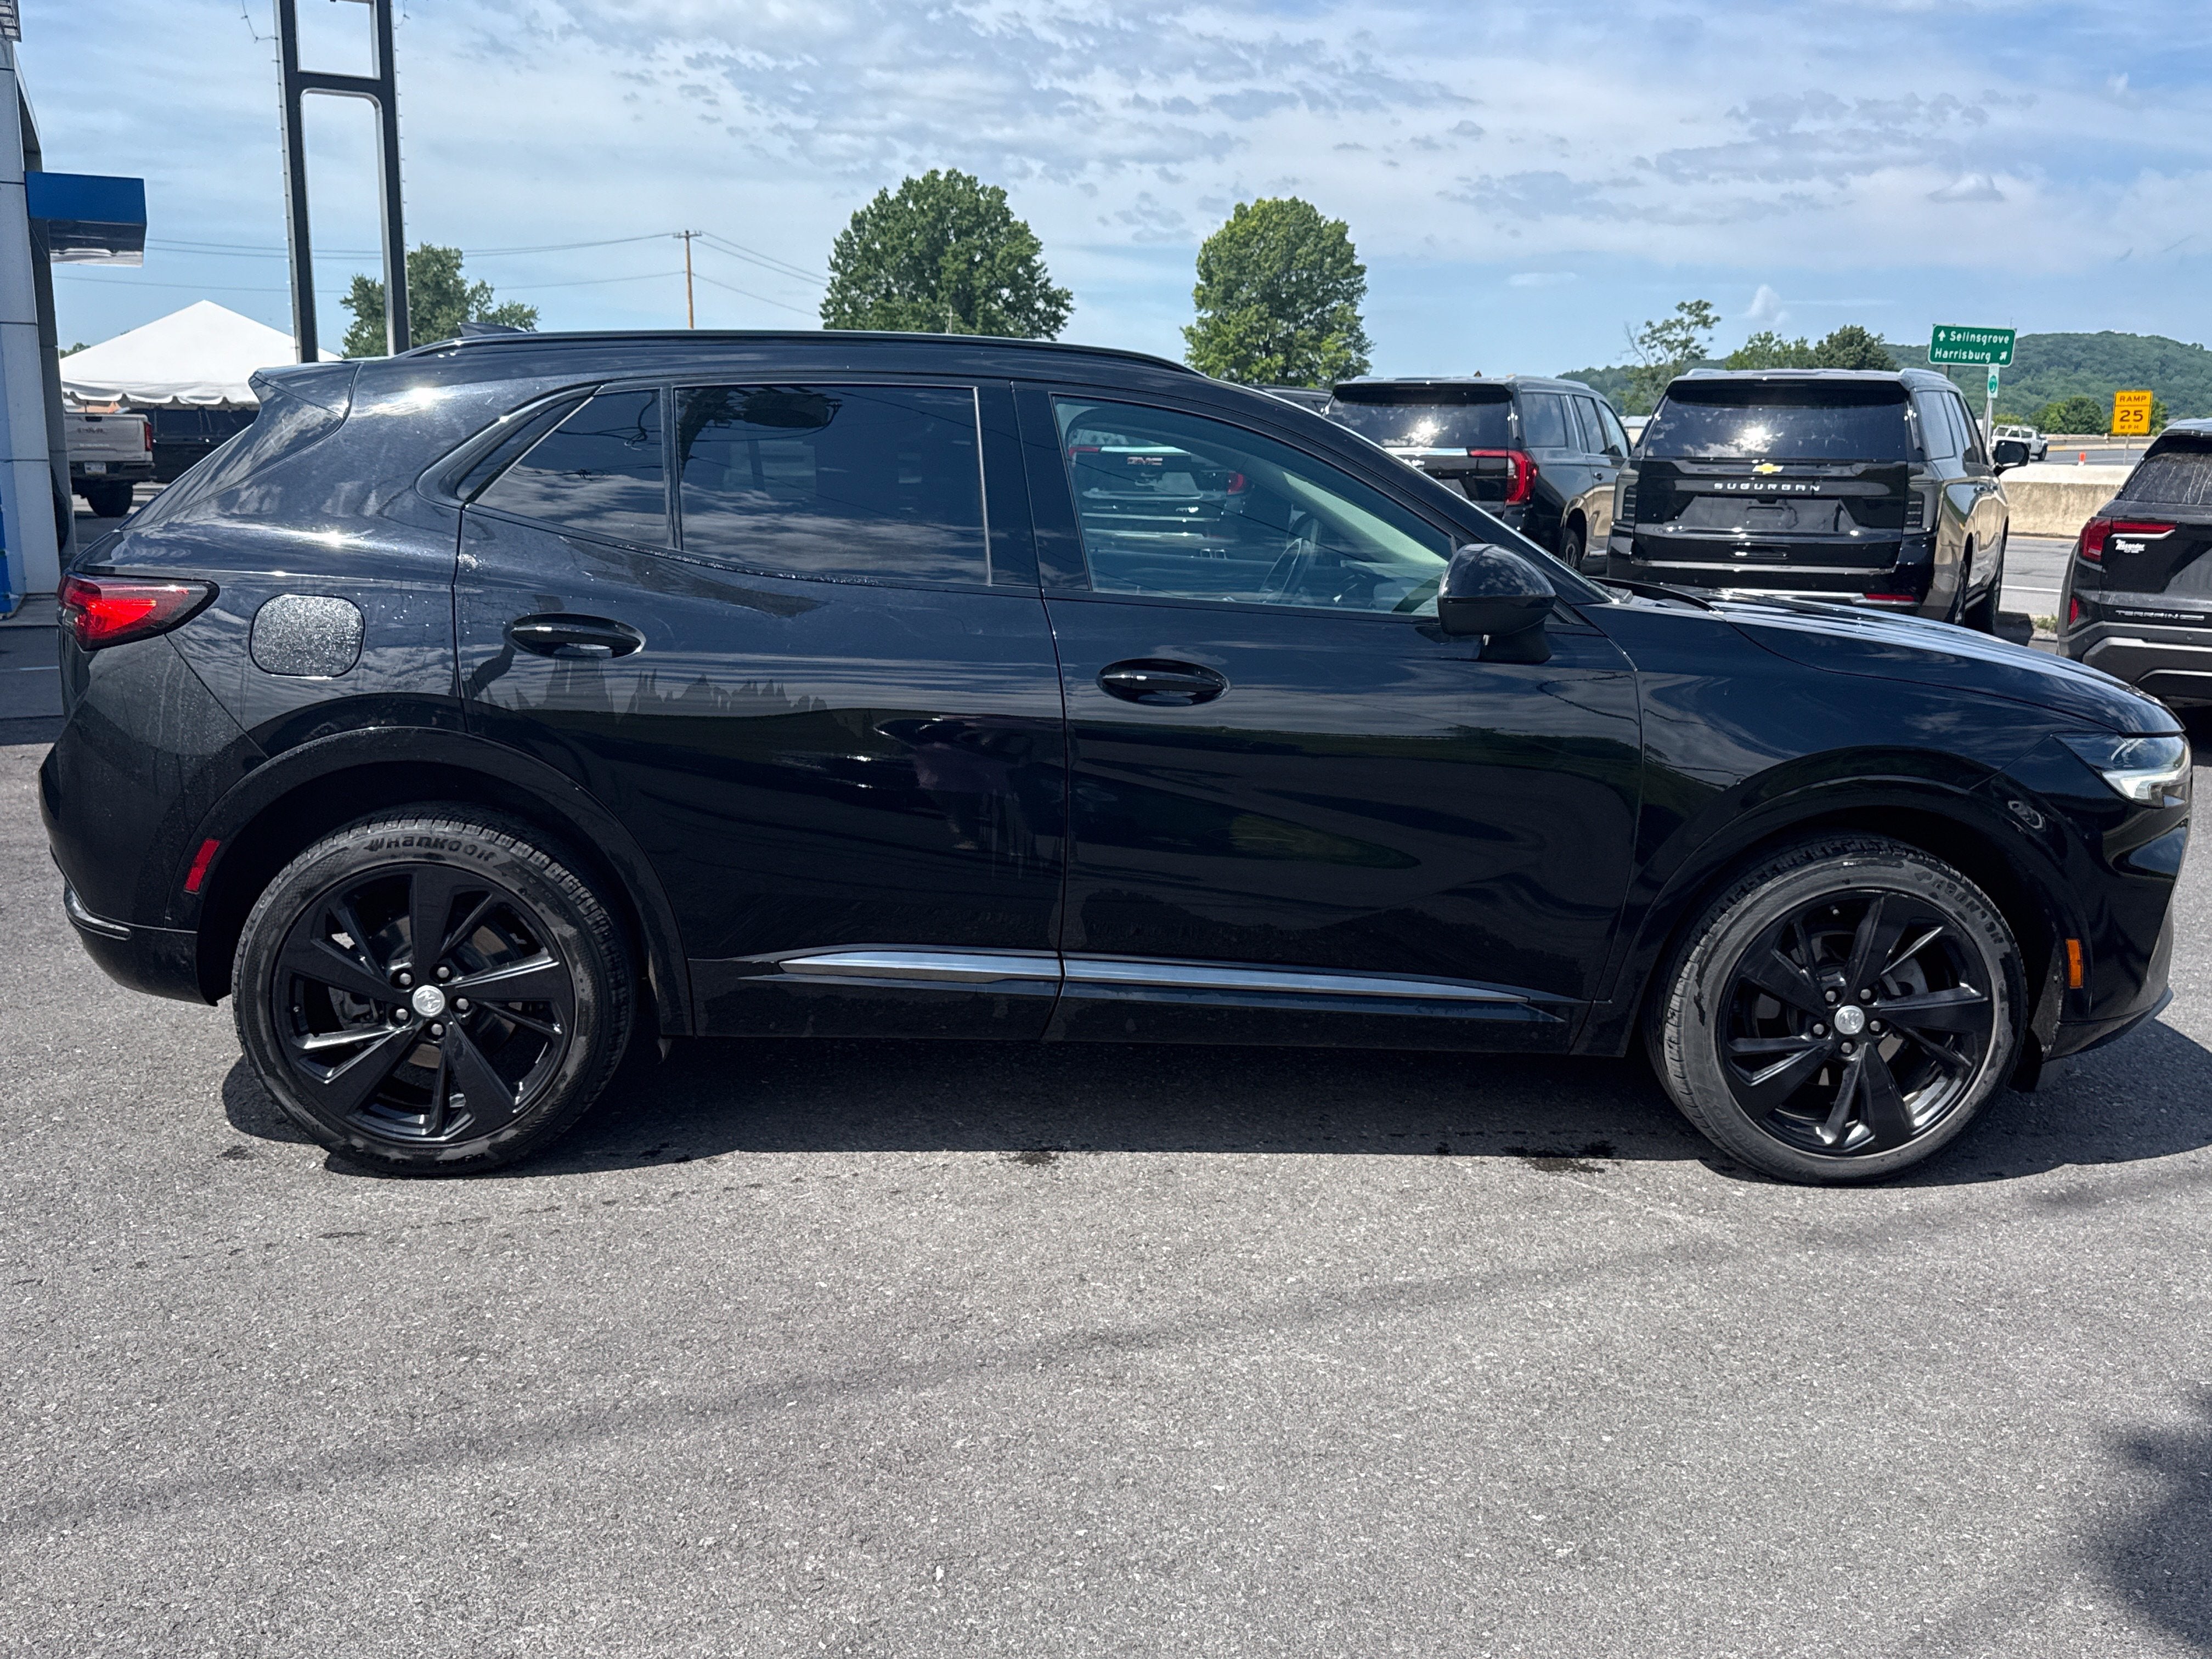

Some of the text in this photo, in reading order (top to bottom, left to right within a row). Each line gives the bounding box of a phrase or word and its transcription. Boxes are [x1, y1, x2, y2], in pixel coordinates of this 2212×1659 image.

[1949, 330, 2010, 346] Selinsgrove
[1934, 347, 1991, 364] Harrisburg
[2119, 409, 2143, 422] 25
[1714, 482, 1821, 492] SUBURBAN
